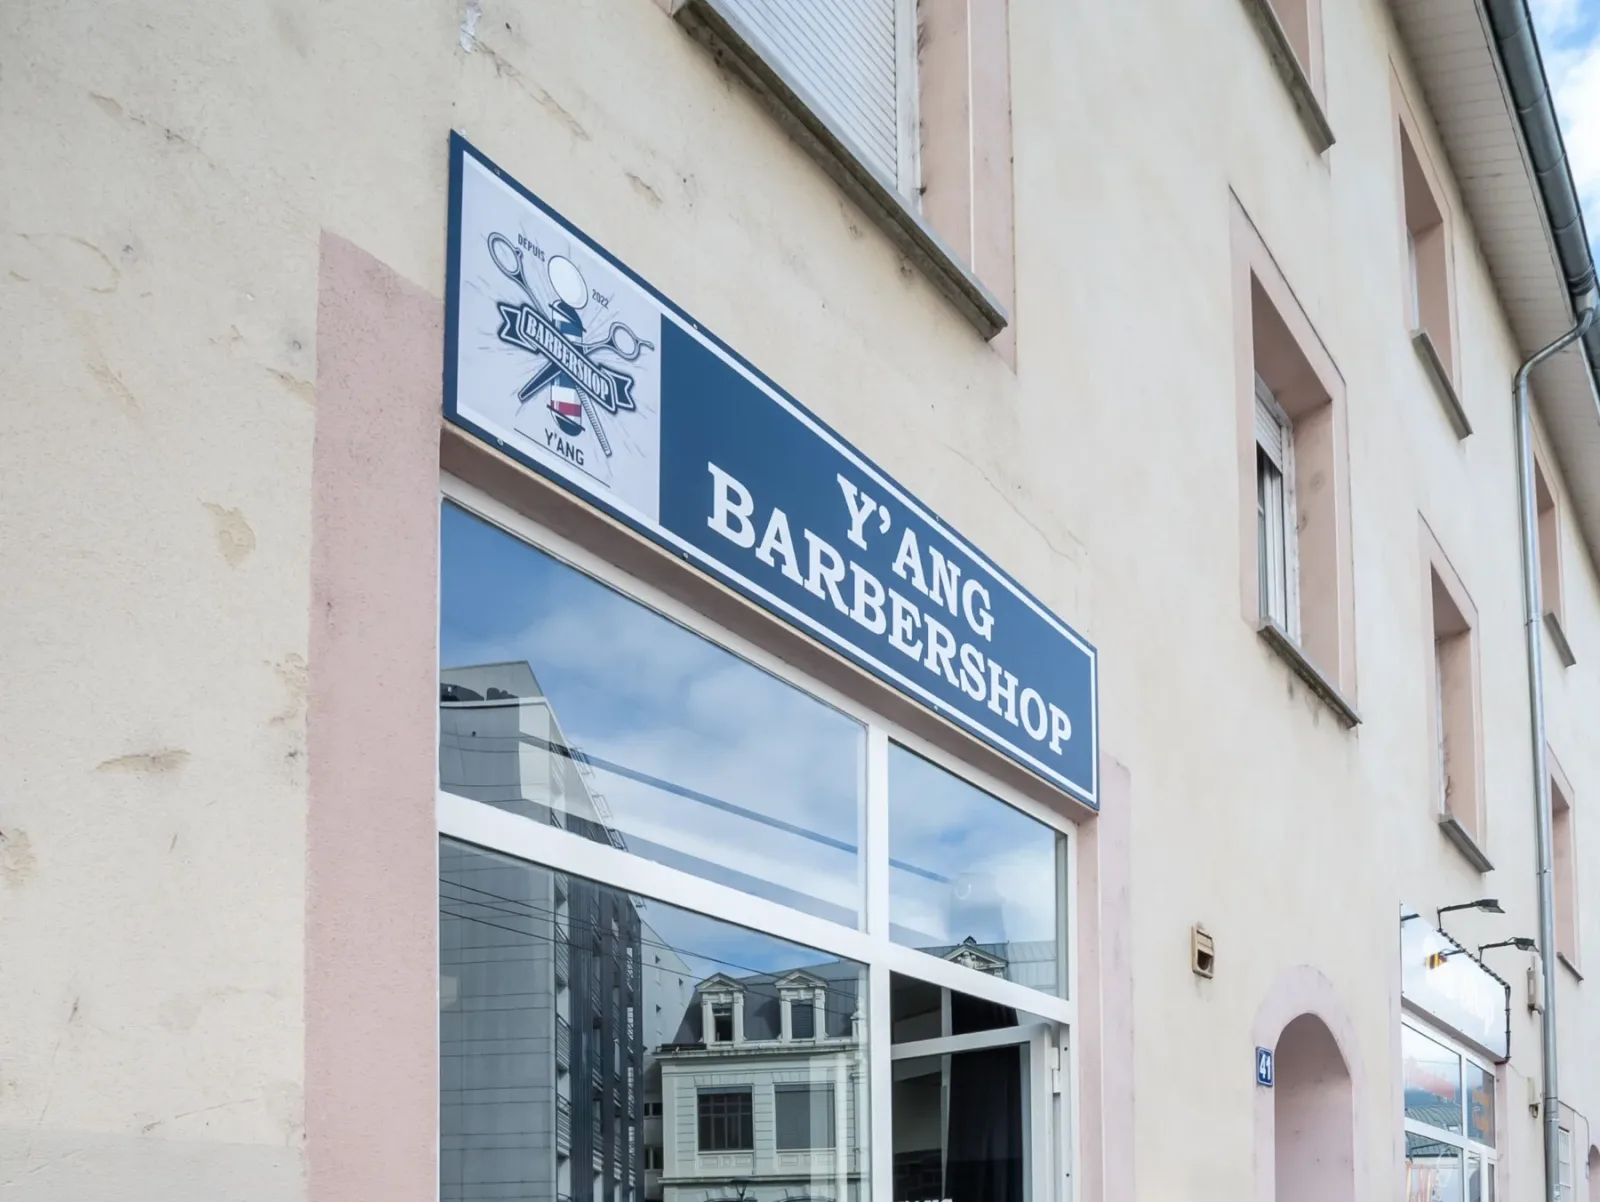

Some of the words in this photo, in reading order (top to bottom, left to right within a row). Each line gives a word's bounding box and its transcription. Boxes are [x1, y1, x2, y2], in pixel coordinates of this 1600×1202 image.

[517, 233, 545, 262] DEPUIS
[591, 288, 610, 310] 2022
[525, 313, 610, 402] BARBERSHOP
[544, 427, 585, 466] Y'ANG
[836, 472, 995, 642] Y'ANG
[706, 461, 1073, 756] BARBERSHOP
[1259, 1053, 1272, 1081] 41
